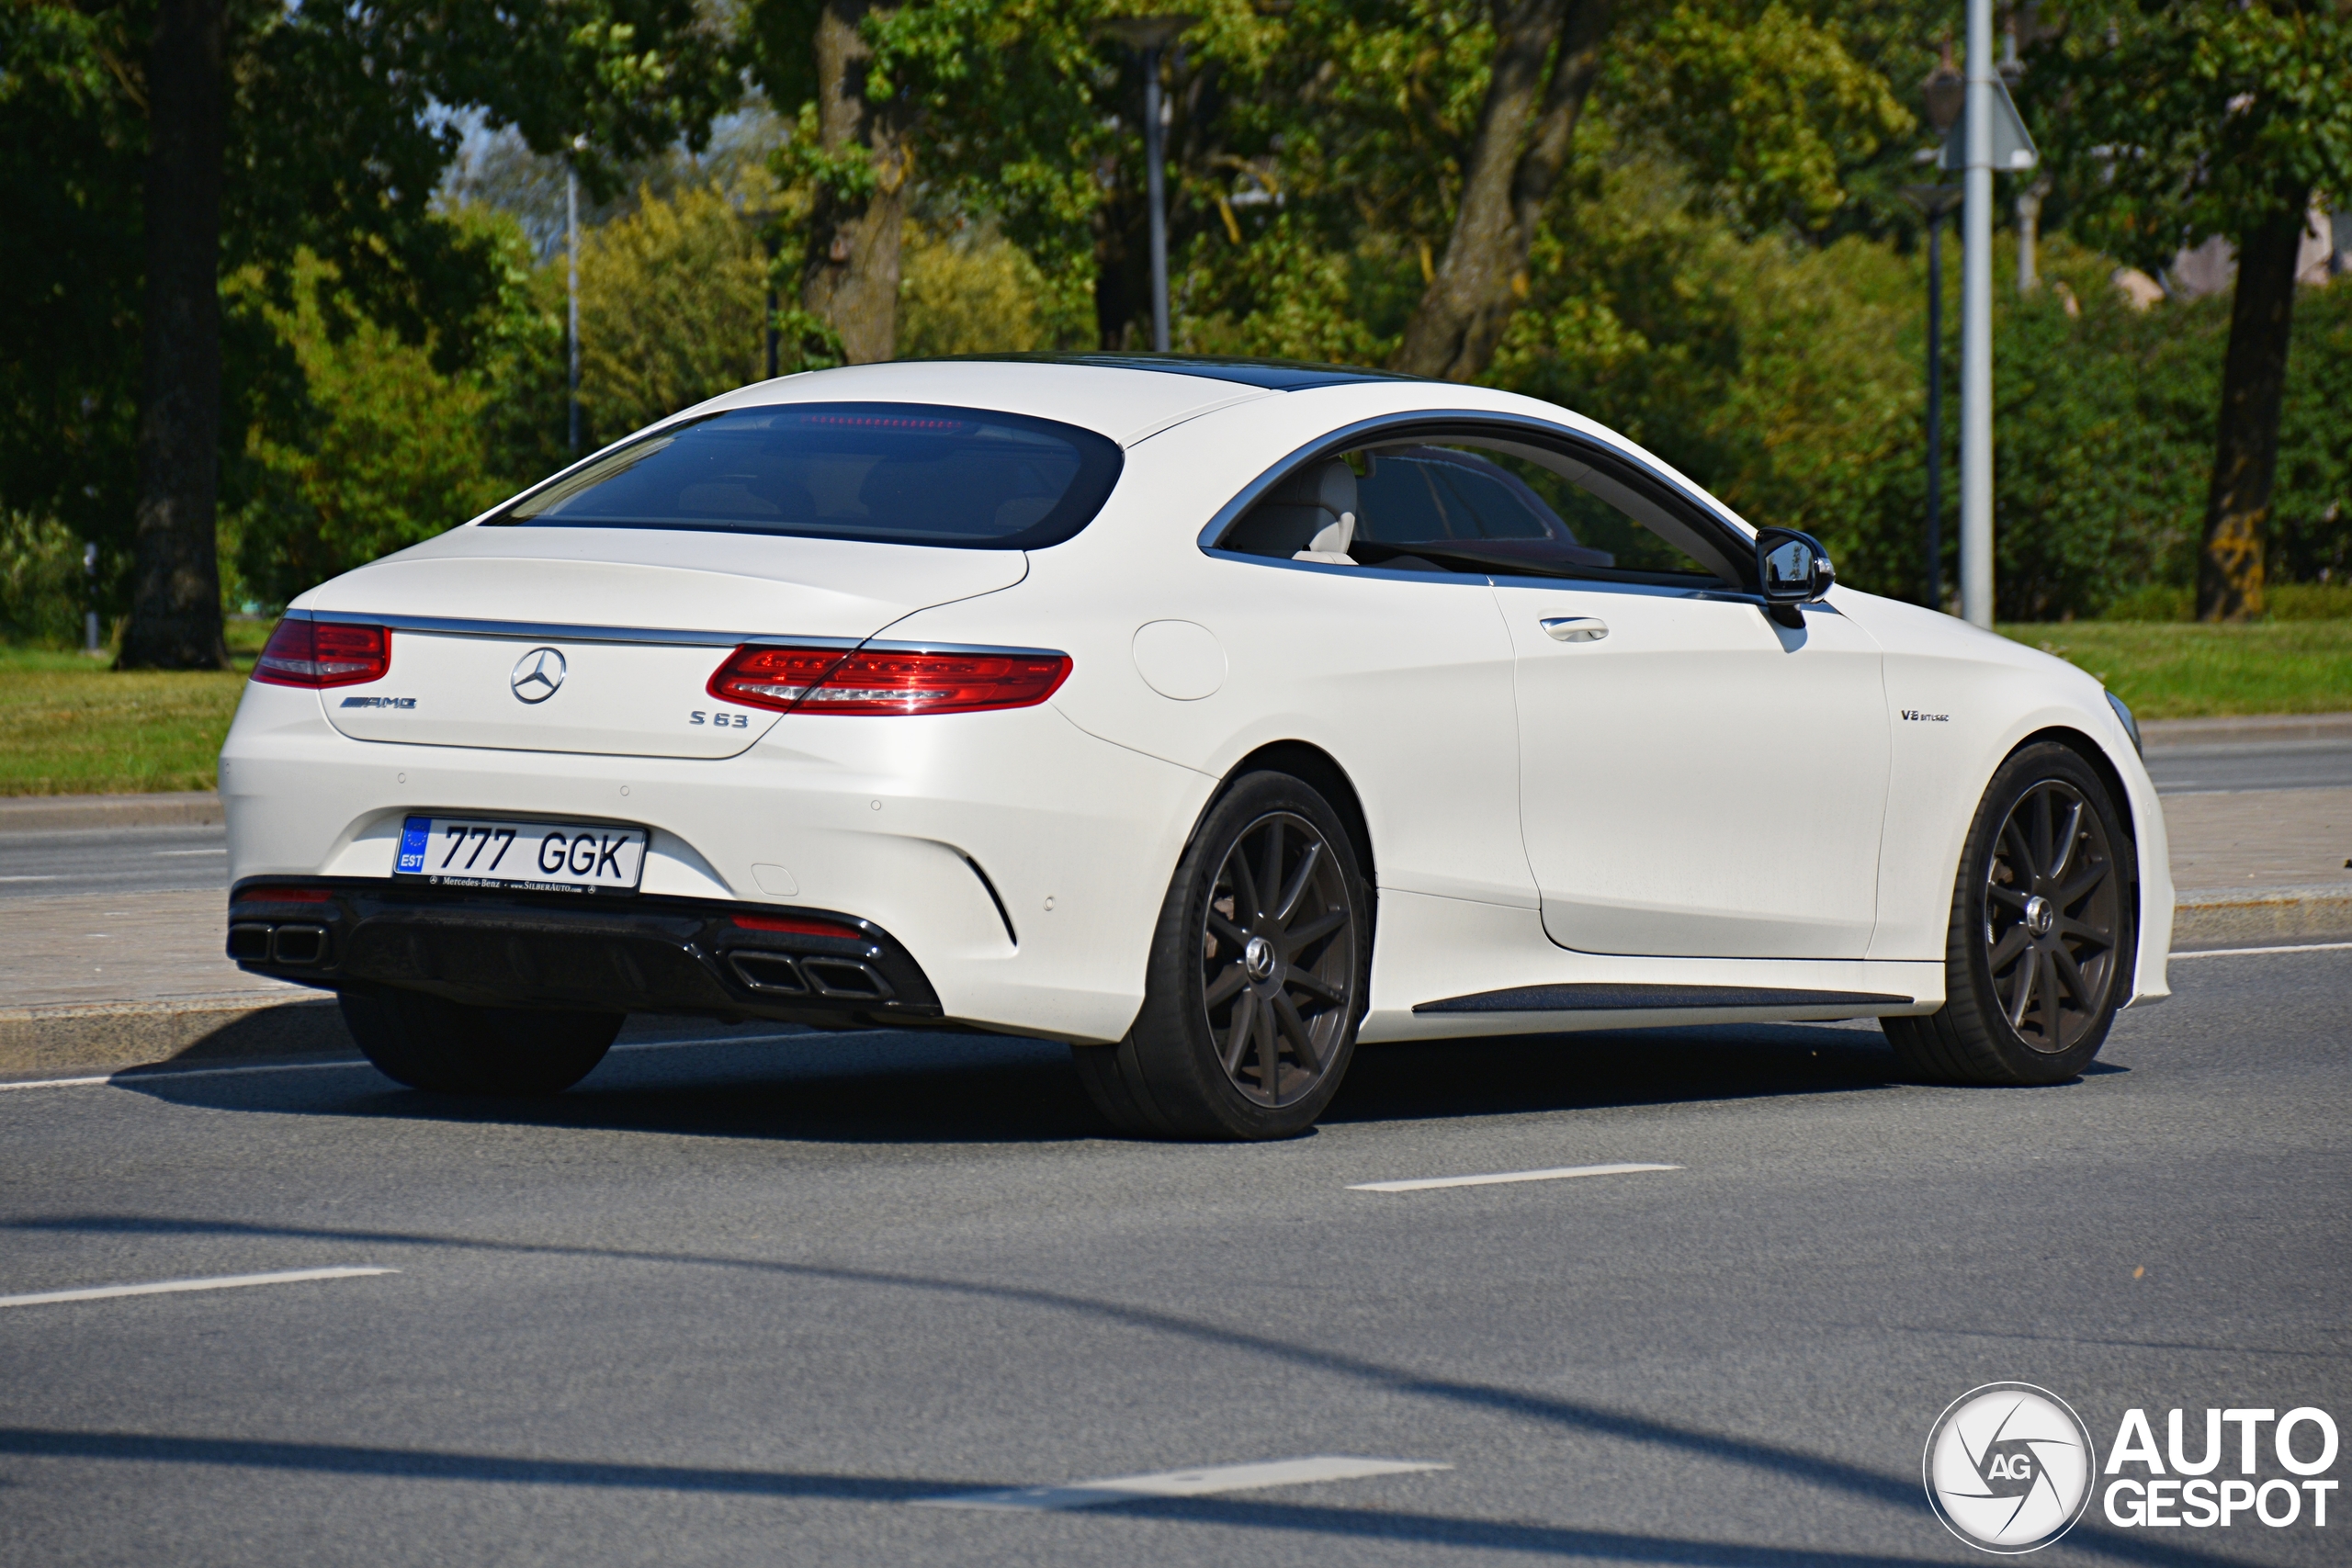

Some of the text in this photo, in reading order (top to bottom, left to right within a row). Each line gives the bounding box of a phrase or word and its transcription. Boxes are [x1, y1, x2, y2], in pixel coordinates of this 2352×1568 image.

[362, 696, 416, 709] AMG
[689, 710, 749, 728] S 63
[1901, 709, 1919, 721] V8
[440, 826, 629, 879] 777 GGK
[401, 853, 424, 867] EST
[442, 876, 501, 889] Mercedes-Benz
